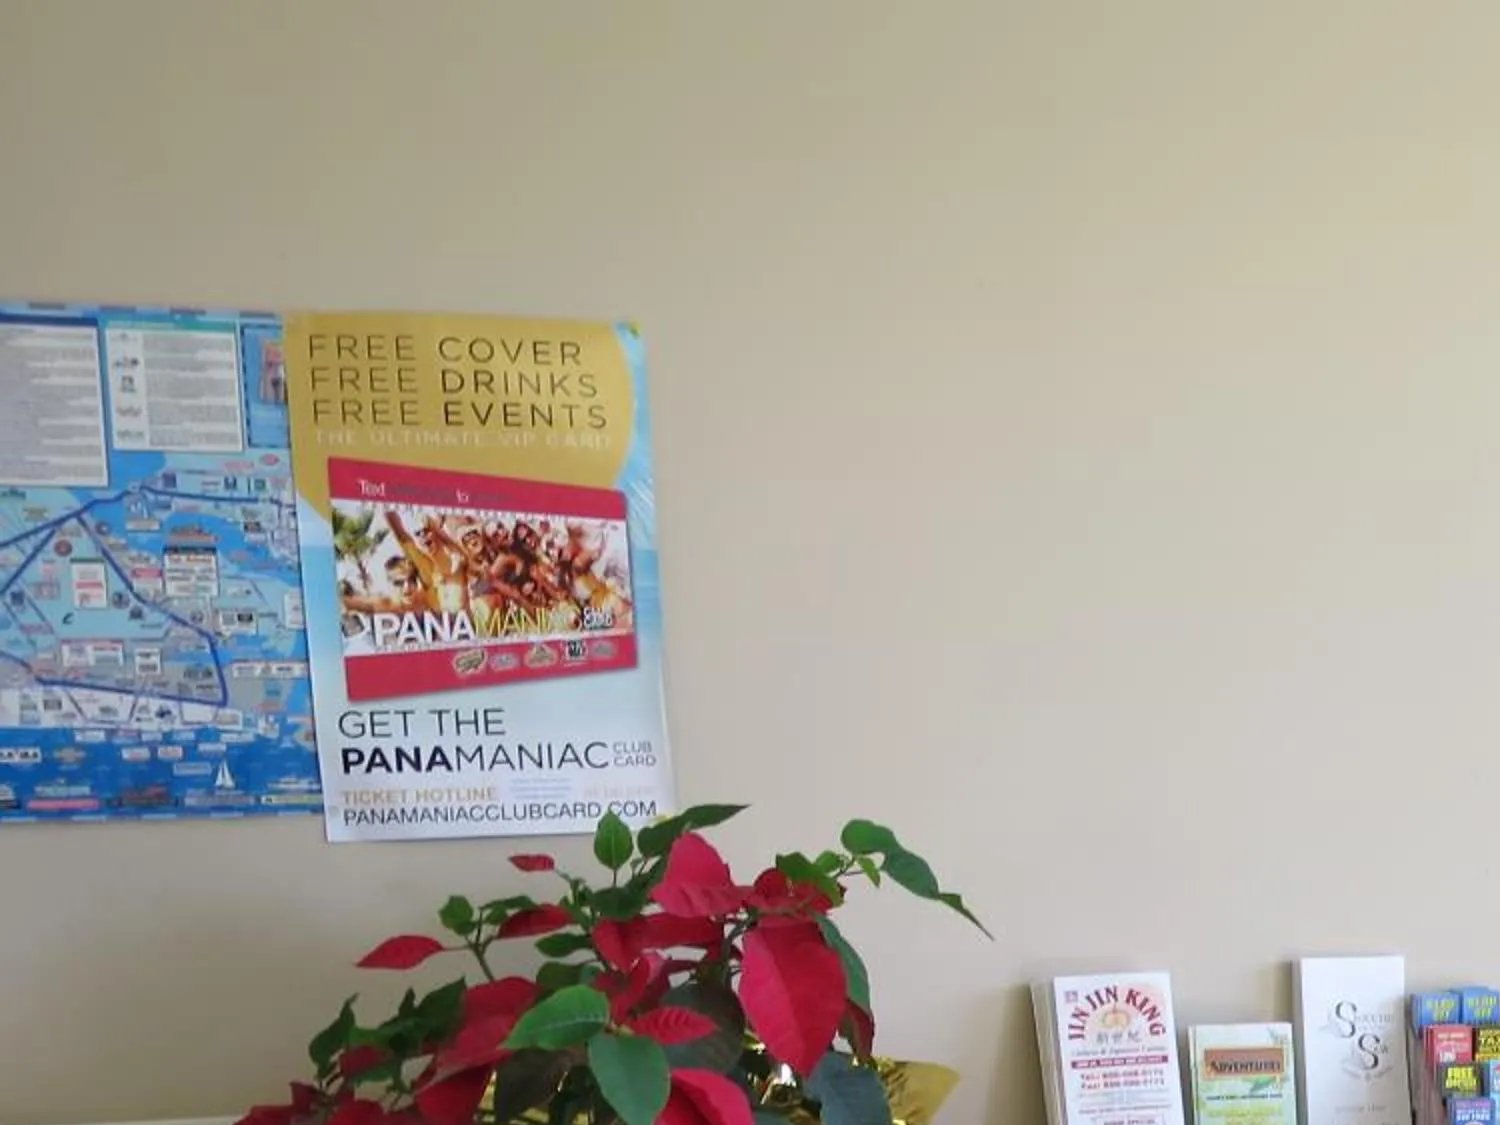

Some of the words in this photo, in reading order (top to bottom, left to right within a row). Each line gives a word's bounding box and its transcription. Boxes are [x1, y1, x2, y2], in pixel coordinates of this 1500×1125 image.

[308, 333, 416, 362] FREE
[438, 336, 582, 366] COVER
[310, 366, 418, 395] FREE
[440, 369, 598, 398] DRINKS
[312, 399, 421, 427] FREE
[443, 401, 609, 430] EVENTS
[337, 708, 416, 739] GET
[428, 707, 507, 737] THE
[341, 741, 610, 775] PANAMANIAC
[612, 755, 657, 768] CARD
[340, 787, 411, 806] TICKET
[416, 785, 497, 803] HOTLINE
